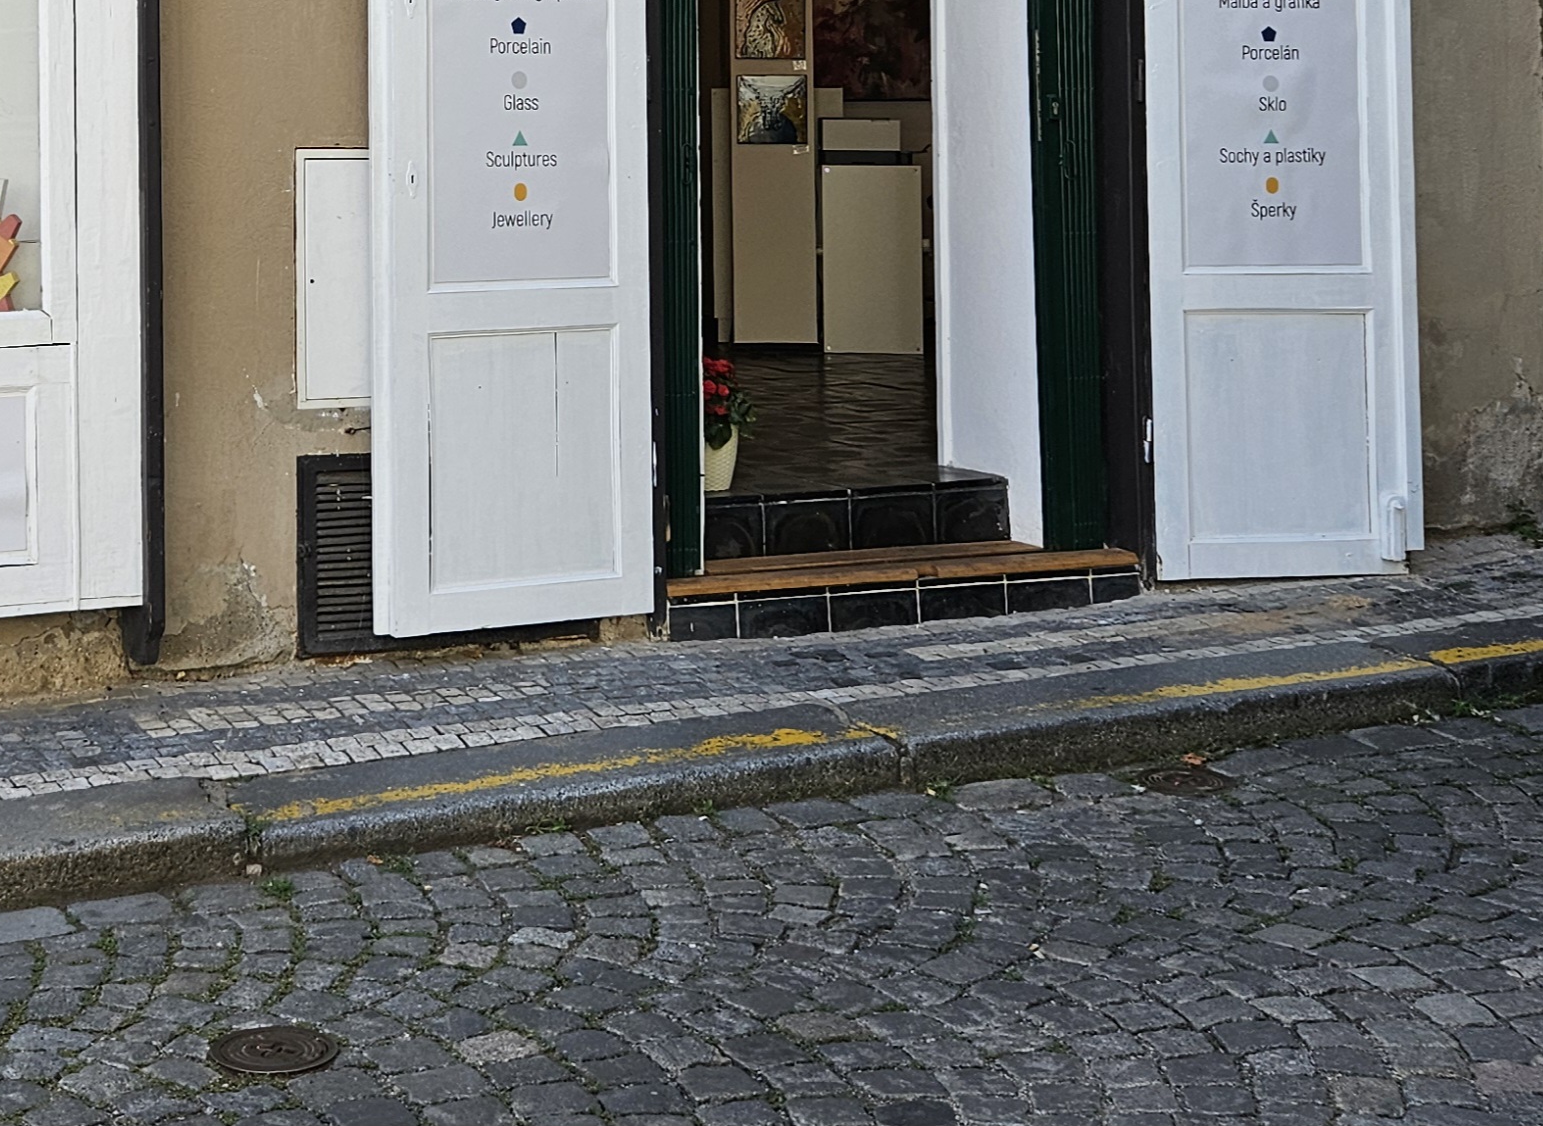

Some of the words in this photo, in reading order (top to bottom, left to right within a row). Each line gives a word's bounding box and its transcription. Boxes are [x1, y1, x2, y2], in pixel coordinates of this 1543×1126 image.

[489, 37, 552, 55] Porcelain
[1241, 44, 1300, 61] Porcelán
[503, 94, 539, 111] Glass
[1258, 96, 1287, 112] Sklo
[485, 150, 558, 171] Sculptures
[1219, 147, 1260, 167] Sochy
[1262, 151, 1272, 164] a
[1275, 147, 1327, 167] plastiky
[1250, 198, 1297, 221] Šperky
[491, 210, 553, 230] Jewellery
